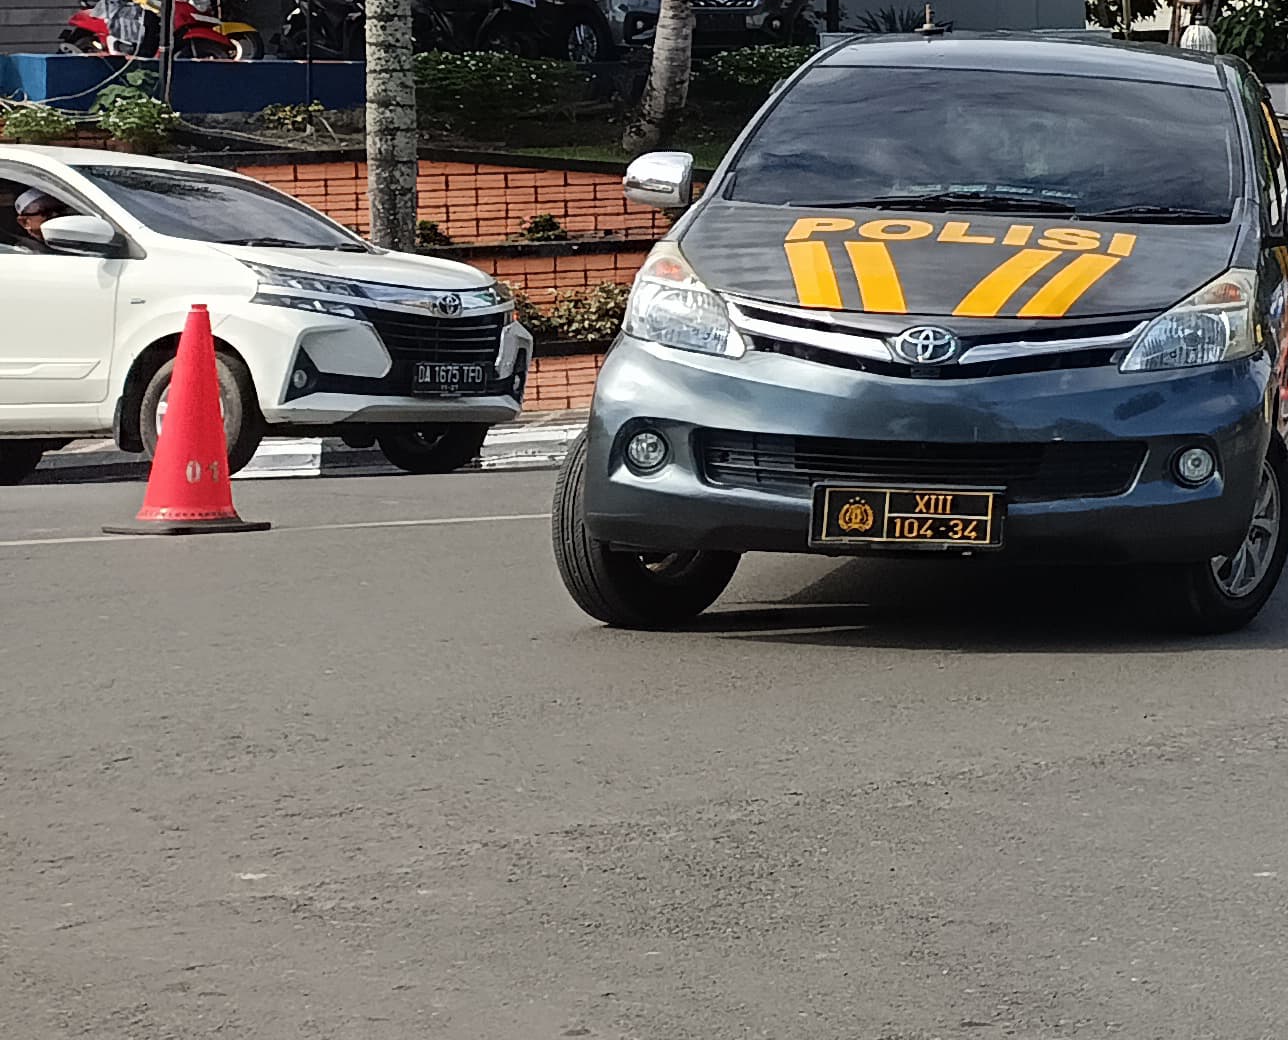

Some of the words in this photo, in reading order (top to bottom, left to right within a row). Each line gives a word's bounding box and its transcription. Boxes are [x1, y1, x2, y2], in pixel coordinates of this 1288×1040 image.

[783, 216, 1137, 257] POLISI
[418, 365, 431, 383] DA
[434, 366, 460, 383] 1675
[914, 494, 953, 514] XIII
[893, 517, 978, 540] 104-34
